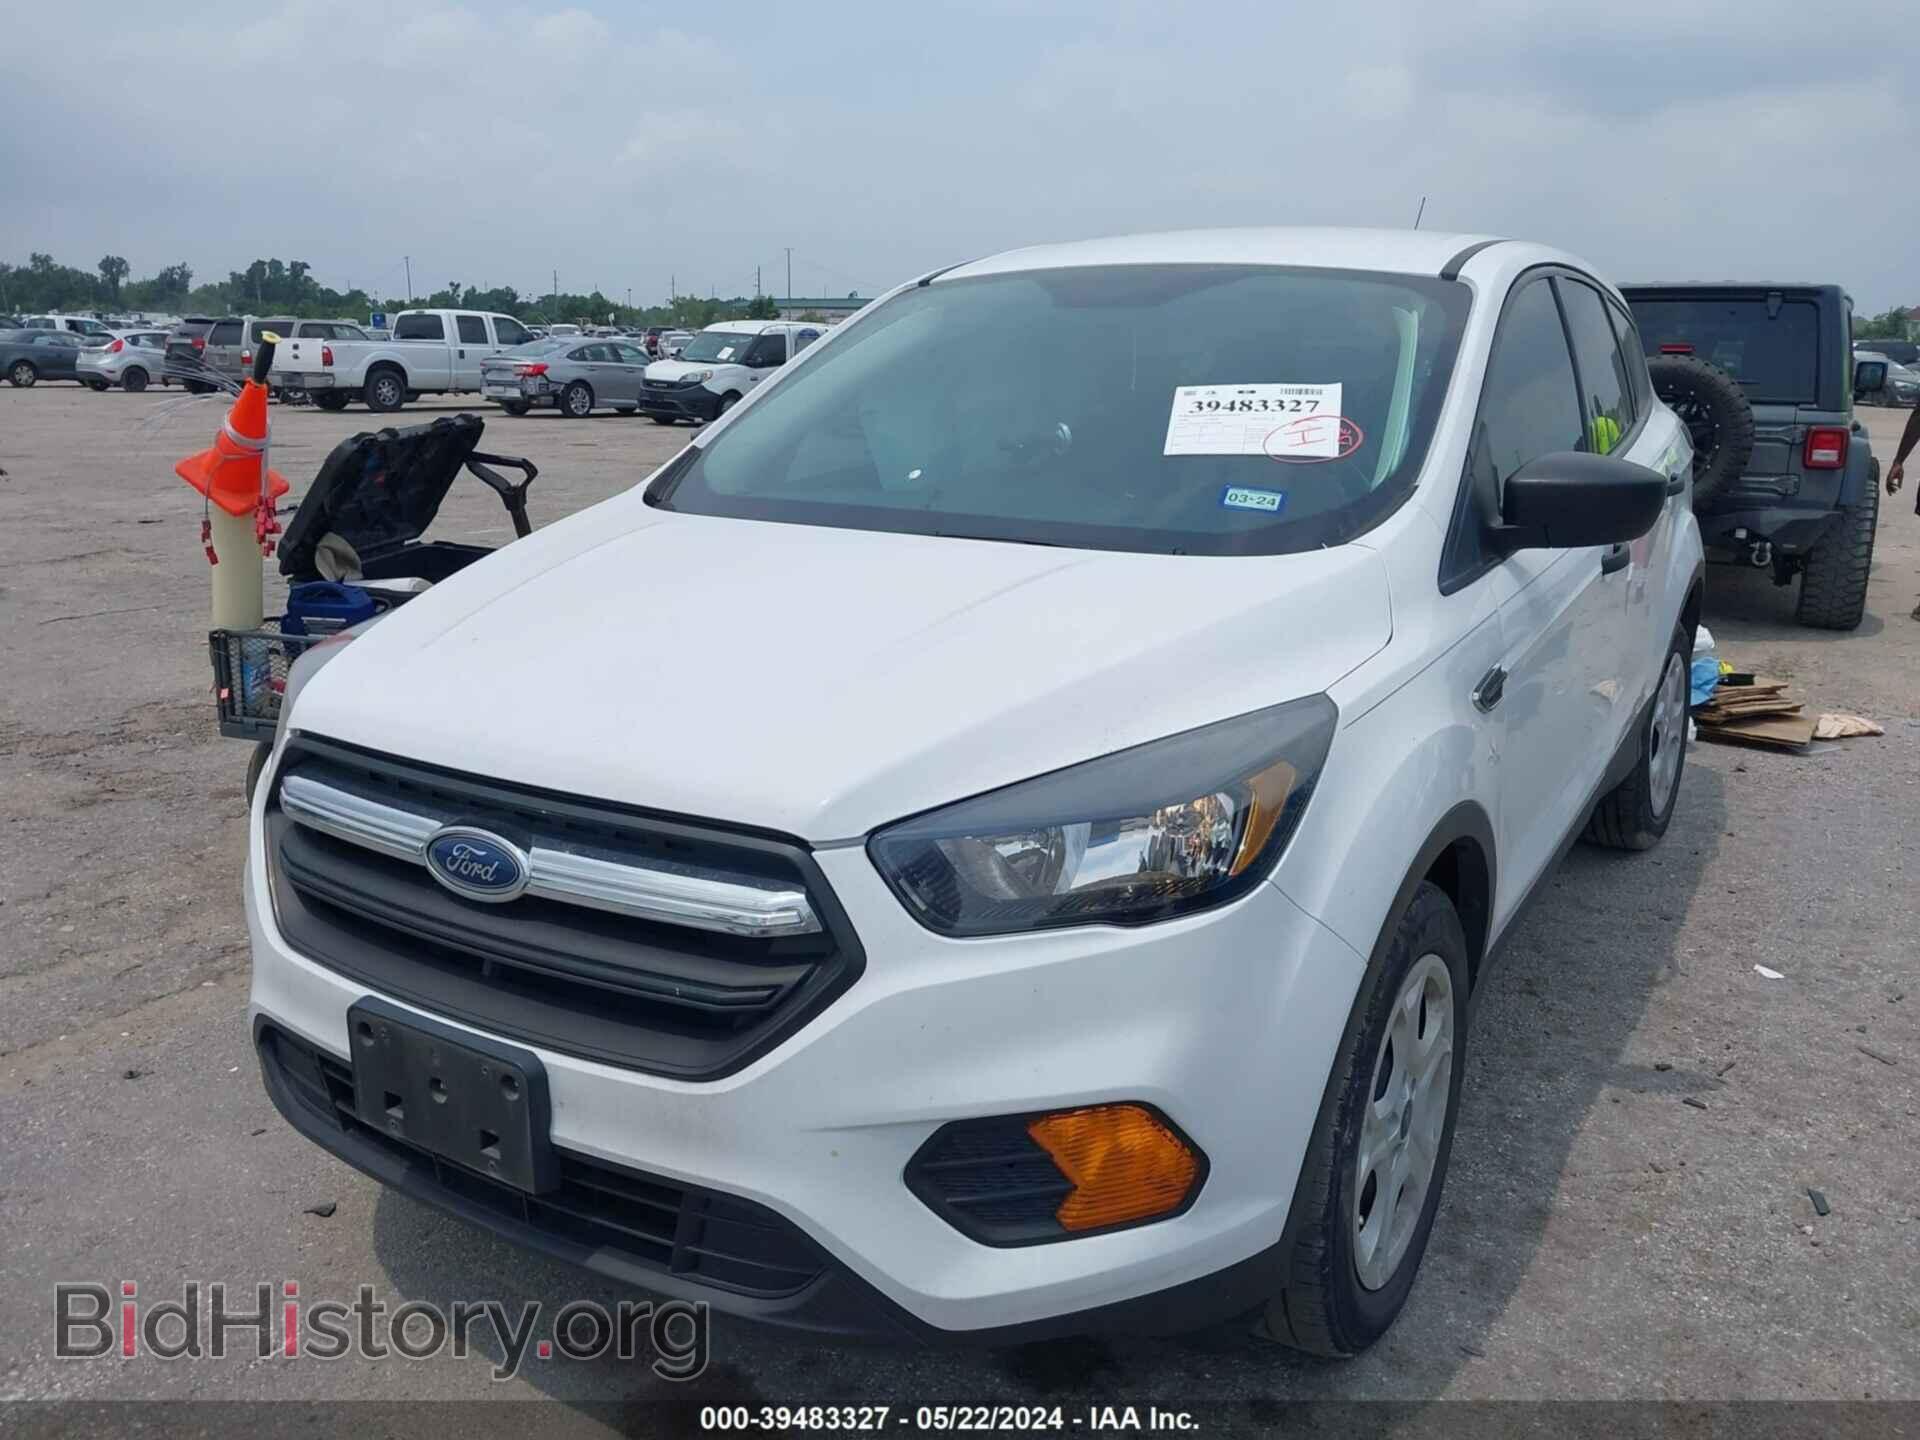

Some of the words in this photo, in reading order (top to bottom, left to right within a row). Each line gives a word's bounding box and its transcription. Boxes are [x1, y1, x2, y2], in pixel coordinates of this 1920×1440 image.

[1188, 399, 1321, 414] 39483327
[1227, 492, 1277, 507] 03-24
[445, 843, 499, 882] Ford
